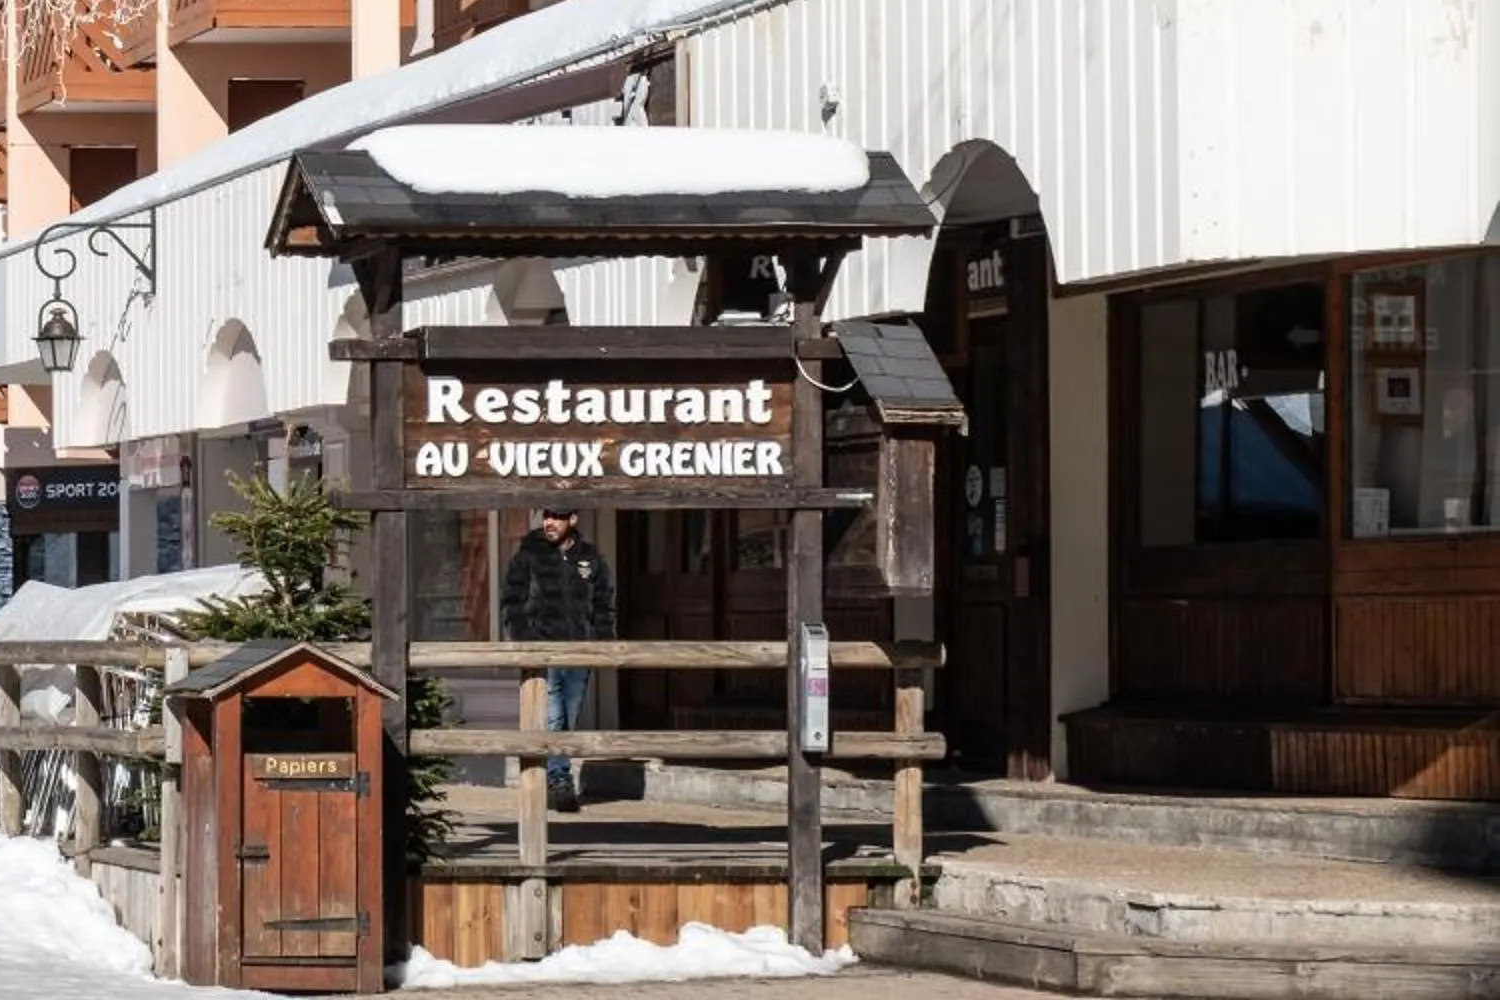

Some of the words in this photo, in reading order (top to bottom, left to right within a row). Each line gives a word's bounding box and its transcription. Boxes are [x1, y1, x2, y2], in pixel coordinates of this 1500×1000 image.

[1205, 349, 1238, 391] BAR
[426, 375, 773, 424] Restaurant
[415, 441, 469, 476] AU
[488, 441, 604, 477] VIEUX
[619, 441, 784, 477] GRENIER
[45, 482, 95, 499] SPORT
[97, 481, 120, 497] 20
[265, 756, 338, 777] Papiers
